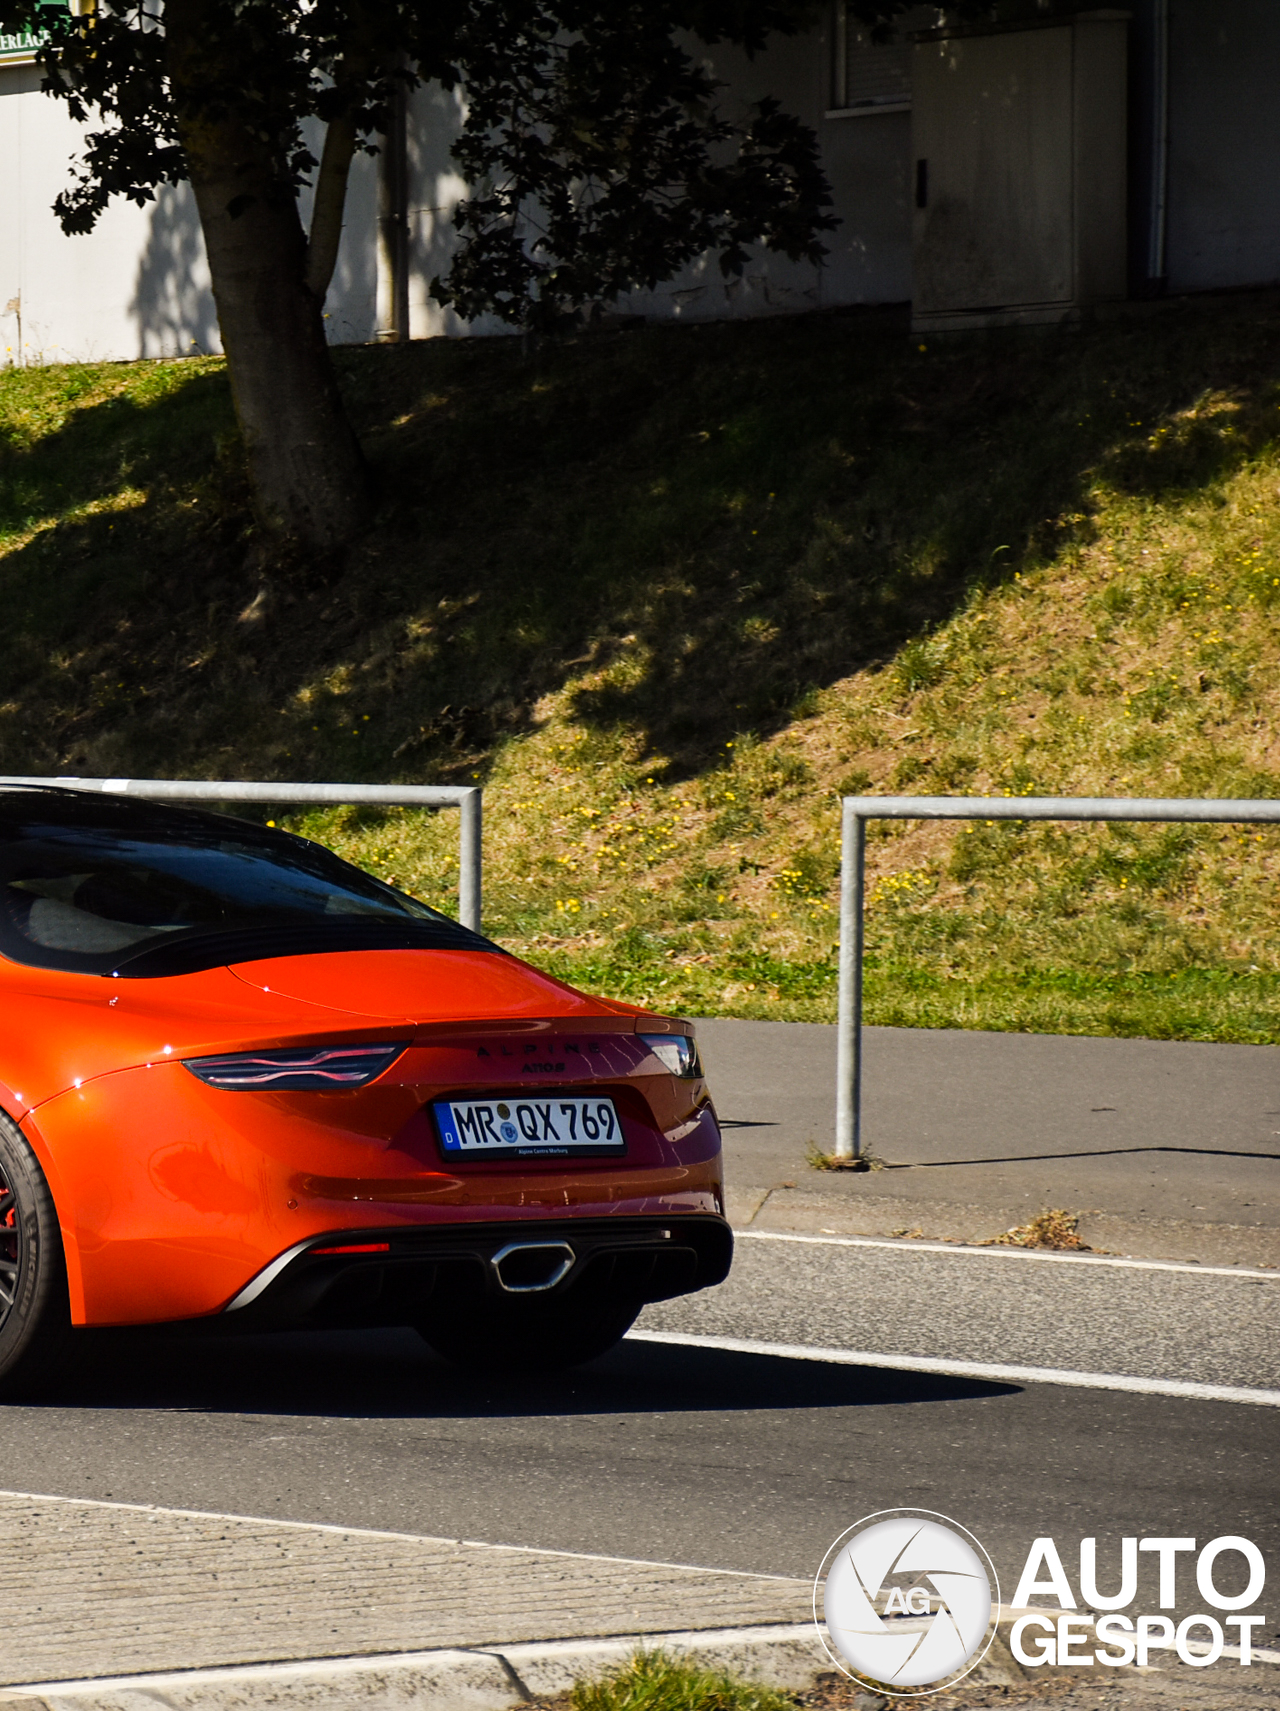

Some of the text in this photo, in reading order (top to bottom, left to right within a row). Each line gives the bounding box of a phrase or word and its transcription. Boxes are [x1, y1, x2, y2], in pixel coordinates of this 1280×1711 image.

[477, 1043, 600, 1057] ALPINE
[453, 1103, 615, 1144] MR QX 769
[445, 1132, 454, 1144] D
